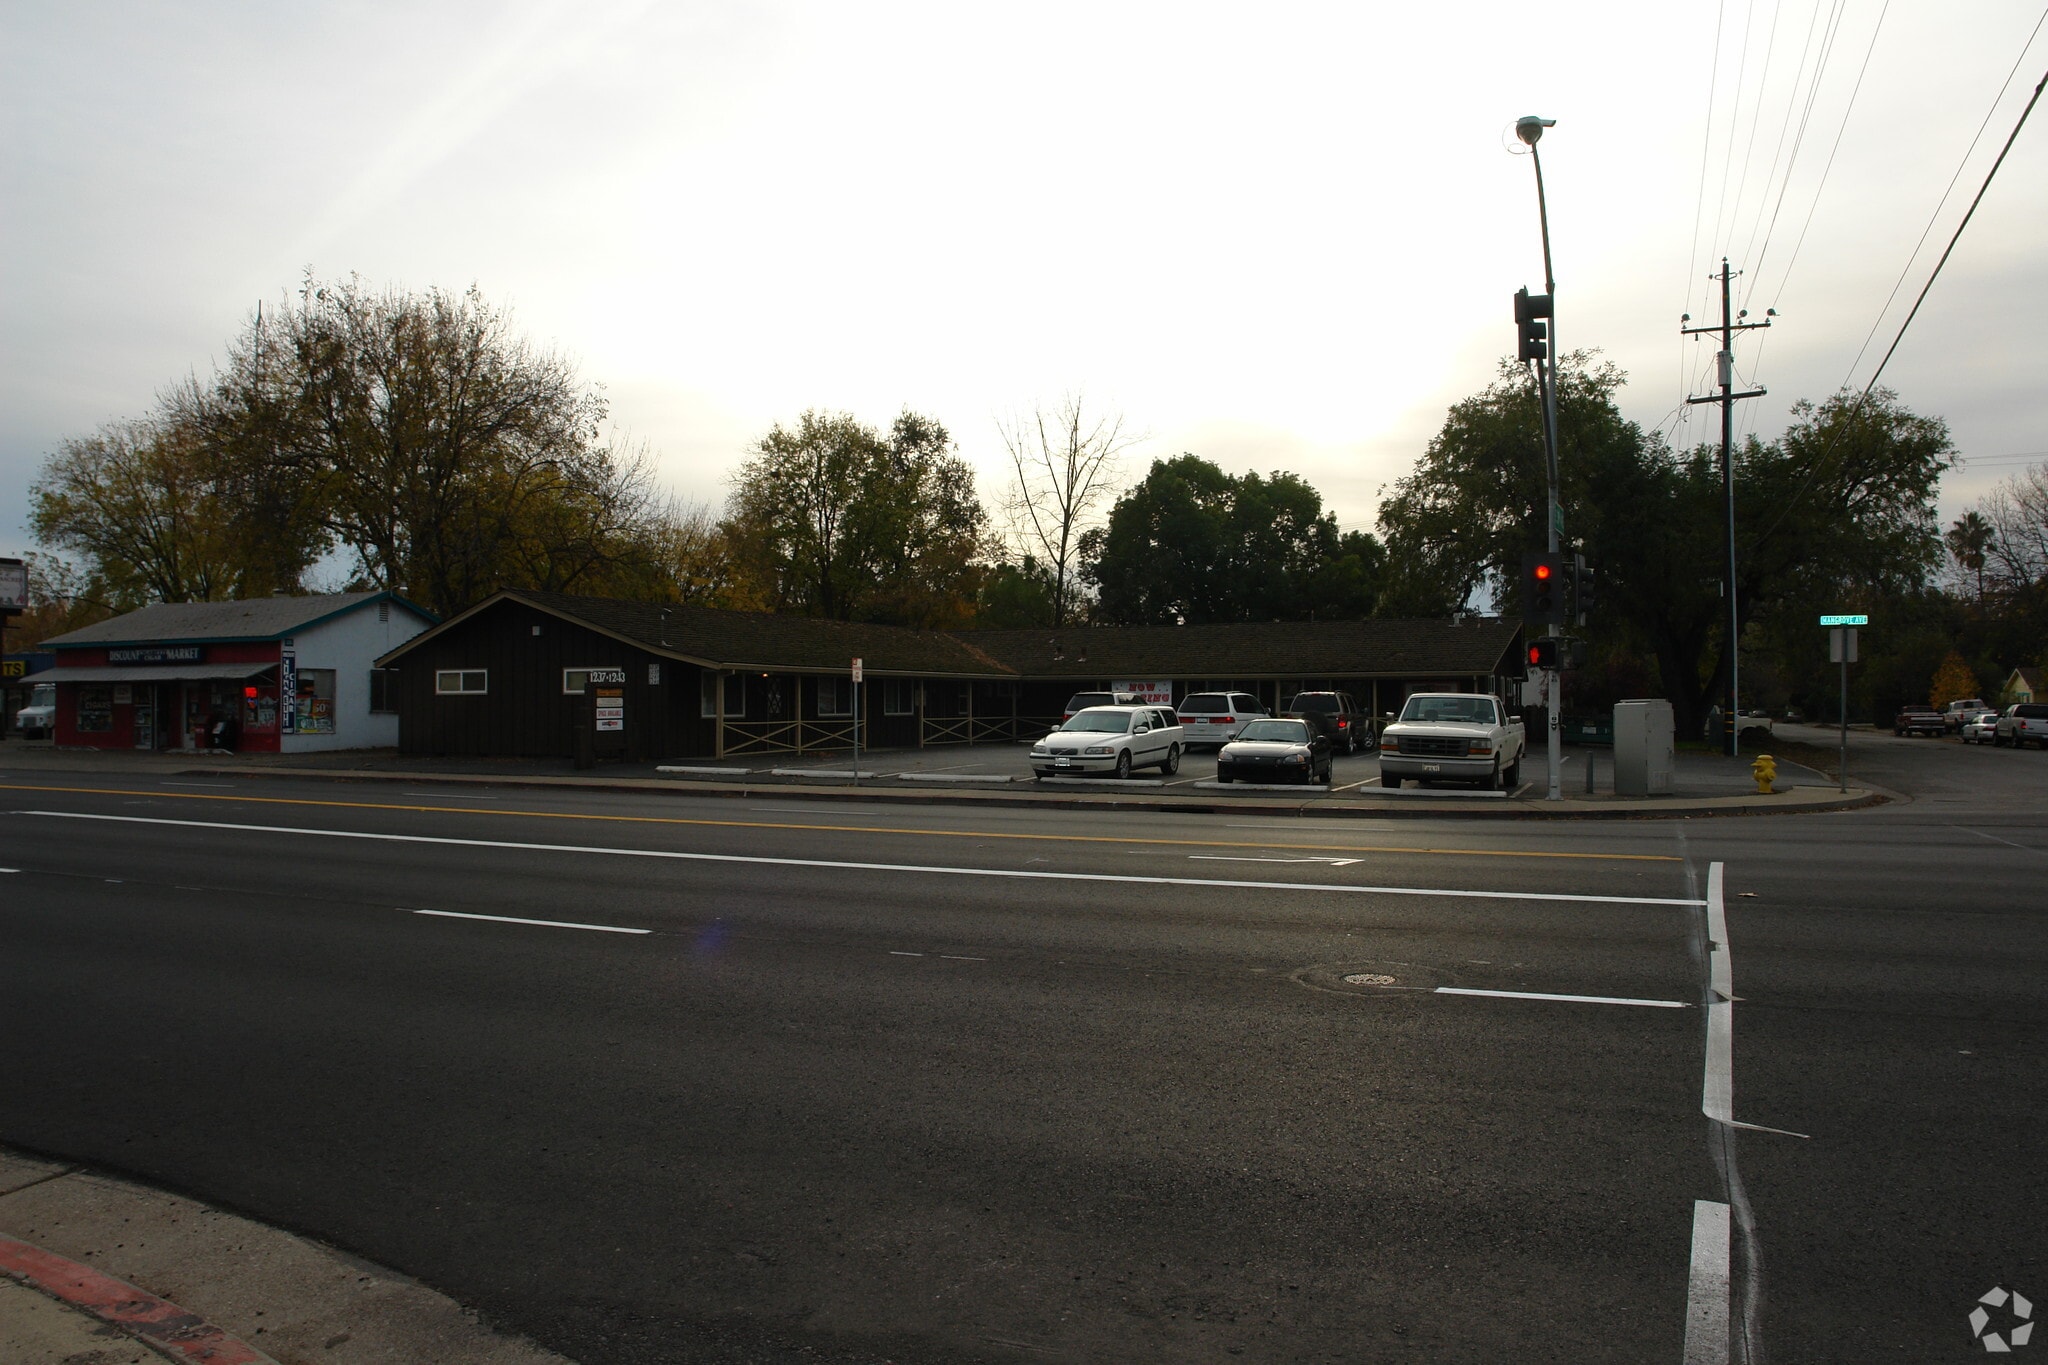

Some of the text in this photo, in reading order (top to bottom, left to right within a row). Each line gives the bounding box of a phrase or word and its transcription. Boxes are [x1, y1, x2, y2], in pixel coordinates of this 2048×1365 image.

[1822, 616, 1868, 624] MANGROVE AVE
[109, 650, 140, 661] DISCOUNT
[166, 648, 200, 660] MARKET
[1129, 683, 1156, 691] NOW
